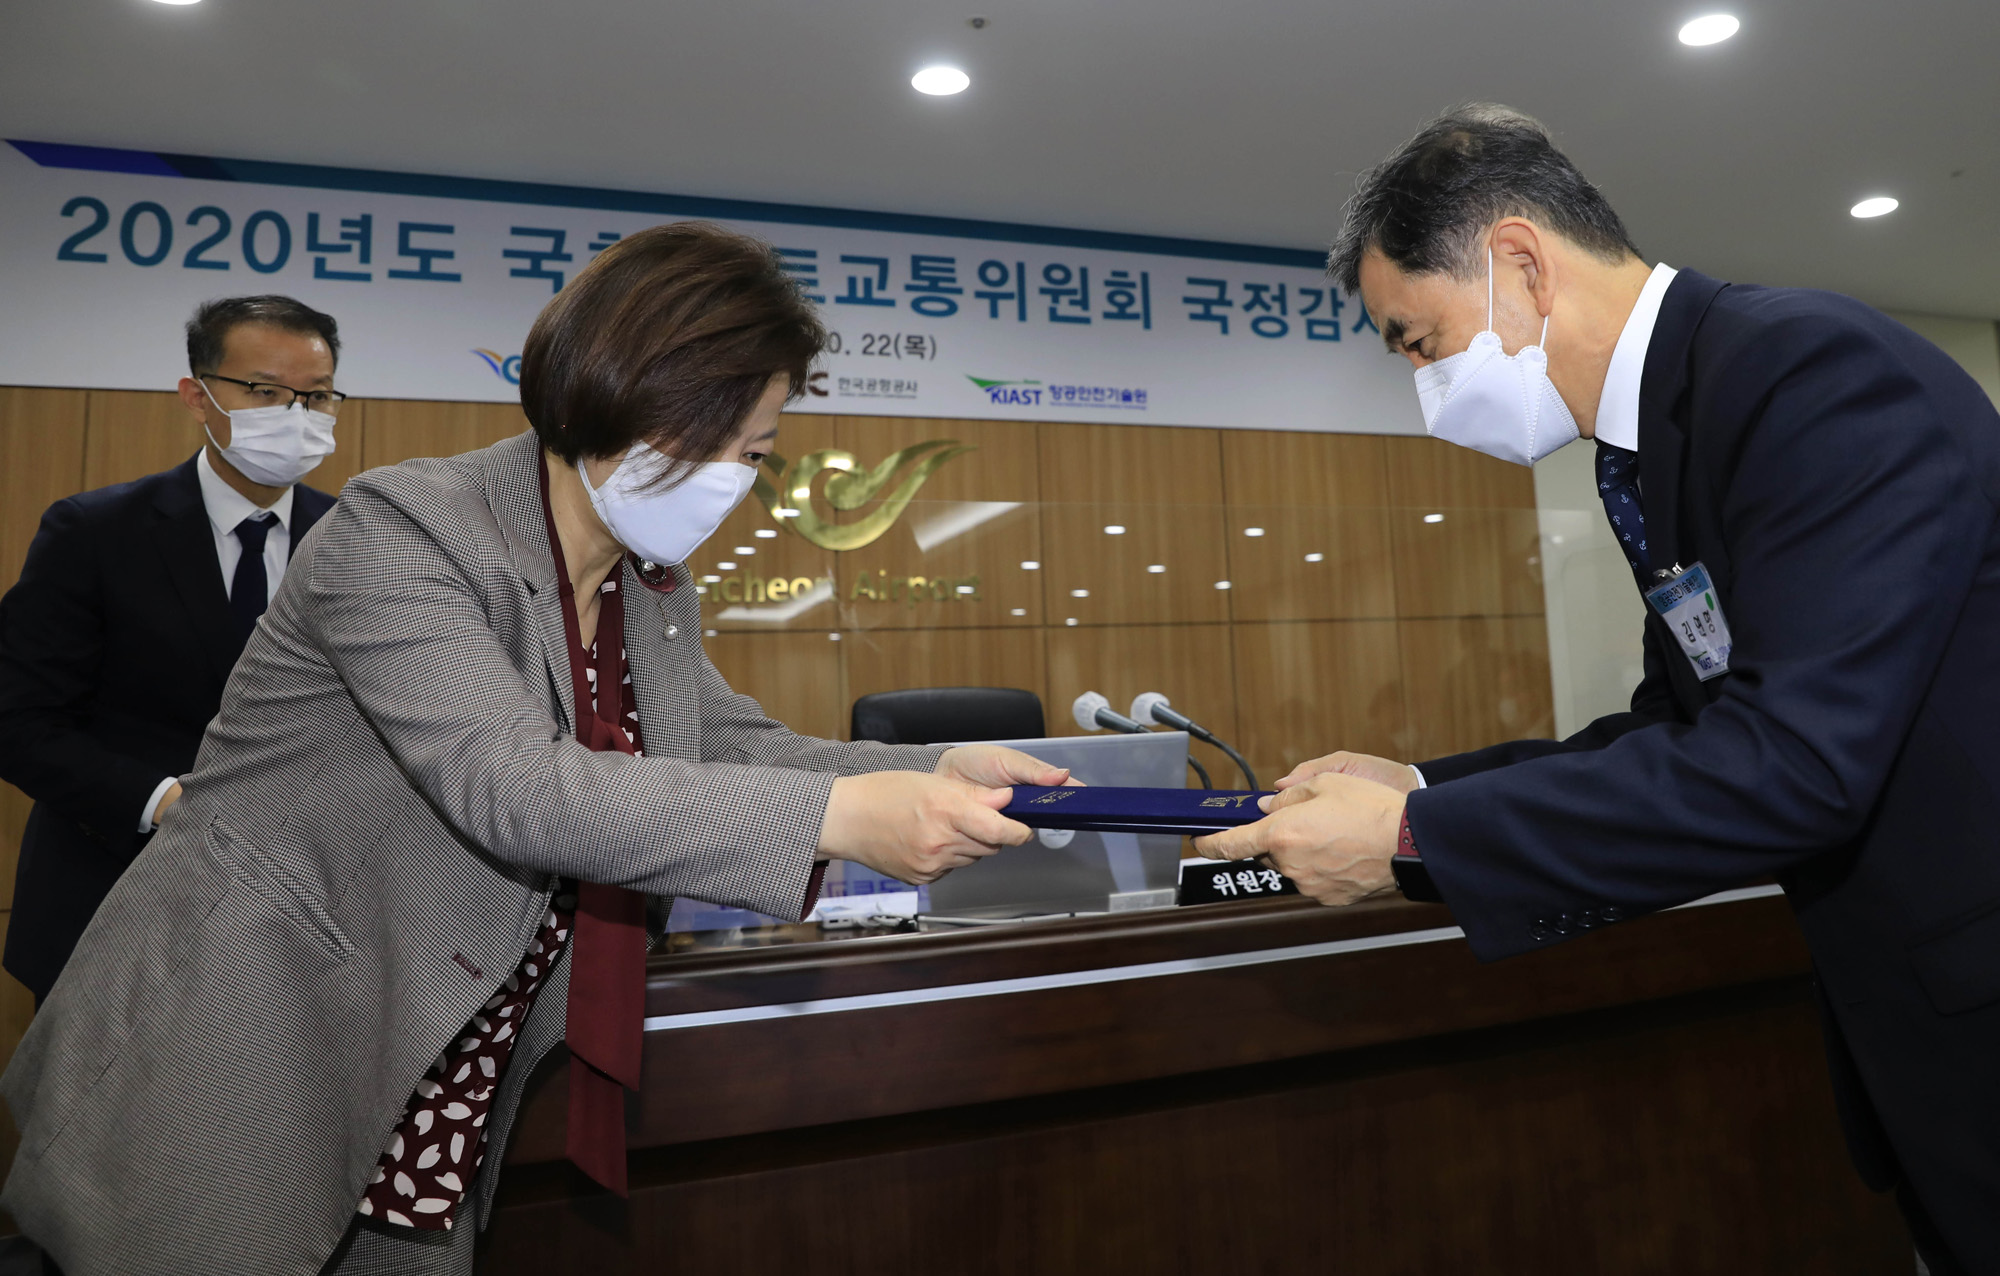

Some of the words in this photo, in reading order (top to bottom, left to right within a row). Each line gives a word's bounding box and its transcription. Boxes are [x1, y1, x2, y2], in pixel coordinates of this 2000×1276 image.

[57, 196, 462, 283] 2020년도
[771, 247, 1152, 330] 토교통위원회
[861, 332, 937, 361] 22(목)
[988, 387, 1043, 406] KIAST
[1048, 385, 1147, 404] 항공안전기술원
[690, 569, 836, 603] ncheon
[851, 569, 981, 609] Airport
[1212, 868, 1283, 896] 위원장
